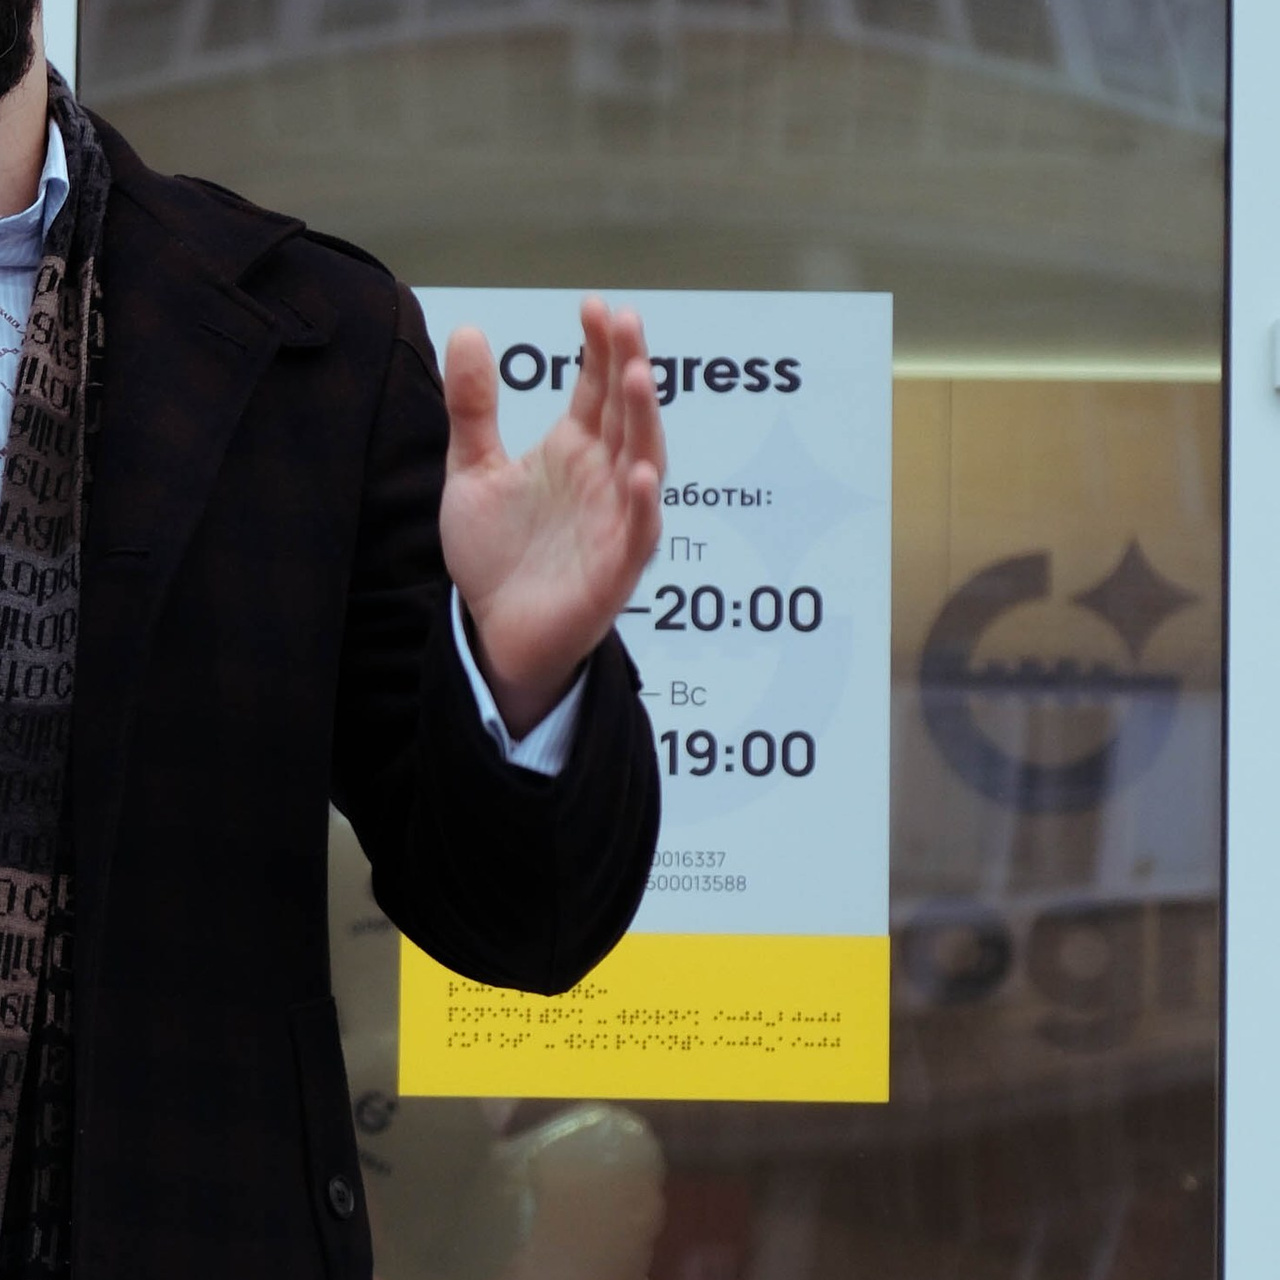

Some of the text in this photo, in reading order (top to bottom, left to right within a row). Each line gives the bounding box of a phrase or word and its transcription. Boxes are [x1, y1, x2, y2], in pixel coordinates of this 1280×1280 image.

[500, 343, 801, 406] Orgress
[664, 483, 772, 507] аботы:
[671, 537, 707, 561] Пт
[671, 681, 707, 706] Вс
